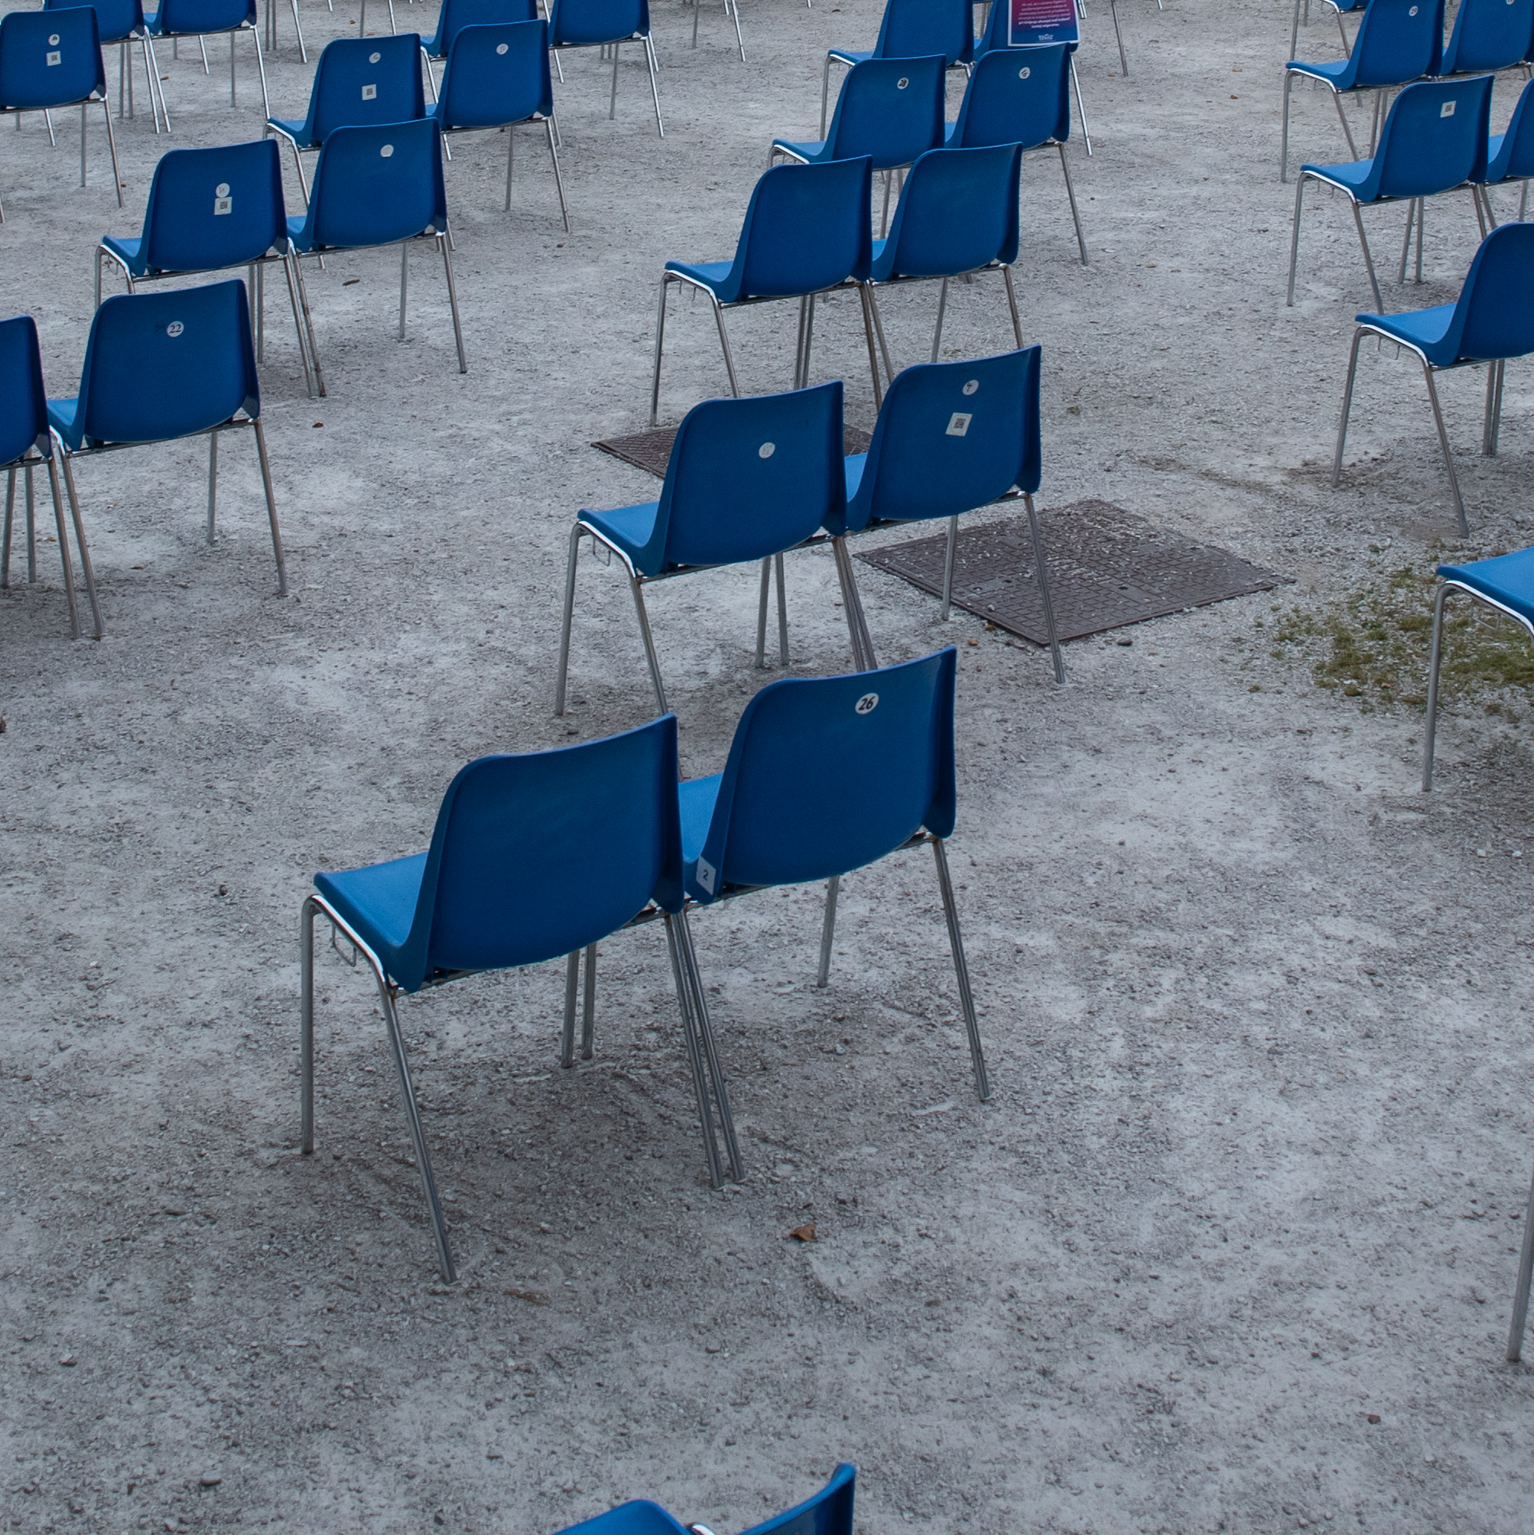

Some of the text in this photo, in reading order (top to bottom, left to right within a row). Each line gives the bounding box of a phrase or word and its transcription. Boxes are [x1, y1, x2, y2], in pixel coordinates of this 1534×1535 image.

[170, 324, 181, 334] 22
[858, 696, 876, 711] 26
[703, 869, 708, 881] 2
